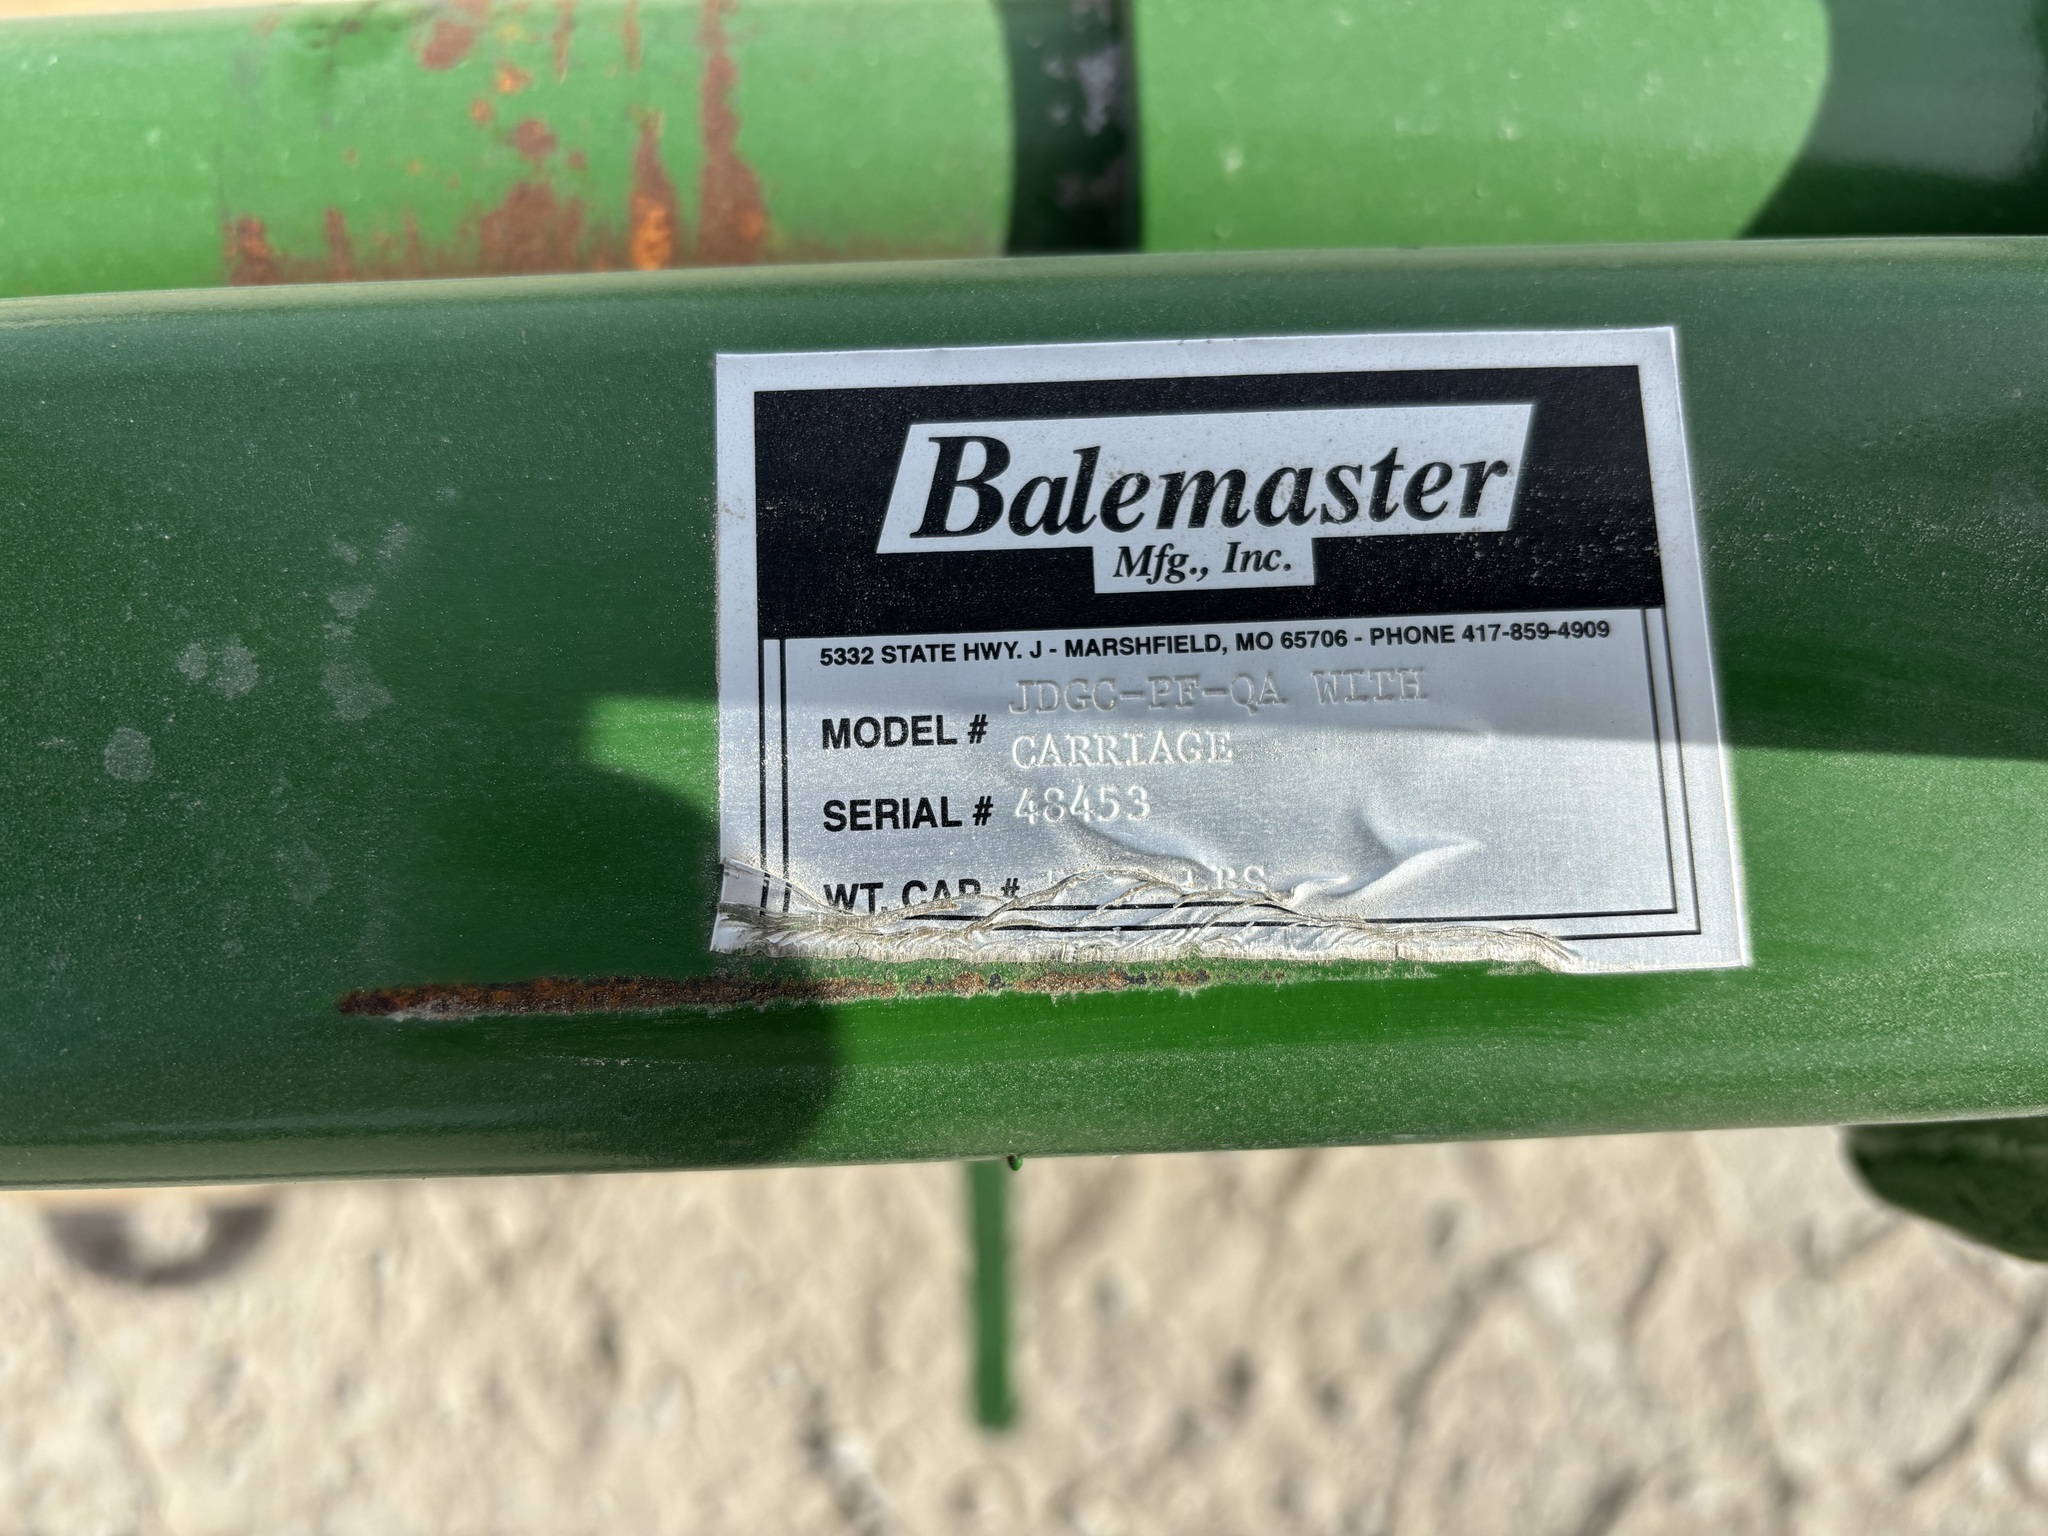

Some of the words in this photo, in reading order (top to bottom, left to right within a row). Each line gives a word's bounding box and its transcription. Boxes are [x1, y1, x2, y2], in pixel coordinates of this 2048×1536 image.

[909, 435, 1509, 540] Balemaster
[1113, 541, 1209, 584] Mfg.,
[1221, 541, 1292, 574] Inc.
[819, 647, 874, 666] 5332
[881, 644, 957, 664] STATE
[963, 641, 1022, 661] HWY.
[1029, 641, 1042, 659] J
[1065, 633, 1228, 658] MARSHFIELD,
[1236, 632, 1274, 652] MO
[1280, 629, 1348, 650] 65706
[1370, 625, 1455, 646] PHONE
[1461, 620, 1611, 644] 417-859-4909
[1008, 672, 1289, 715] JDGC-PF-QA
[1311, 667, 1429, 706] WITH
[821, 715, 958, 750] MODEL
[967, 714, 988, 744] #
[1011, 730, 1234, 769] CARRIAGE
[823, 797, 963, 832] SERIAL
[973, 796, 994, 827] #
[1014, 783, 1151, 825] 48453
